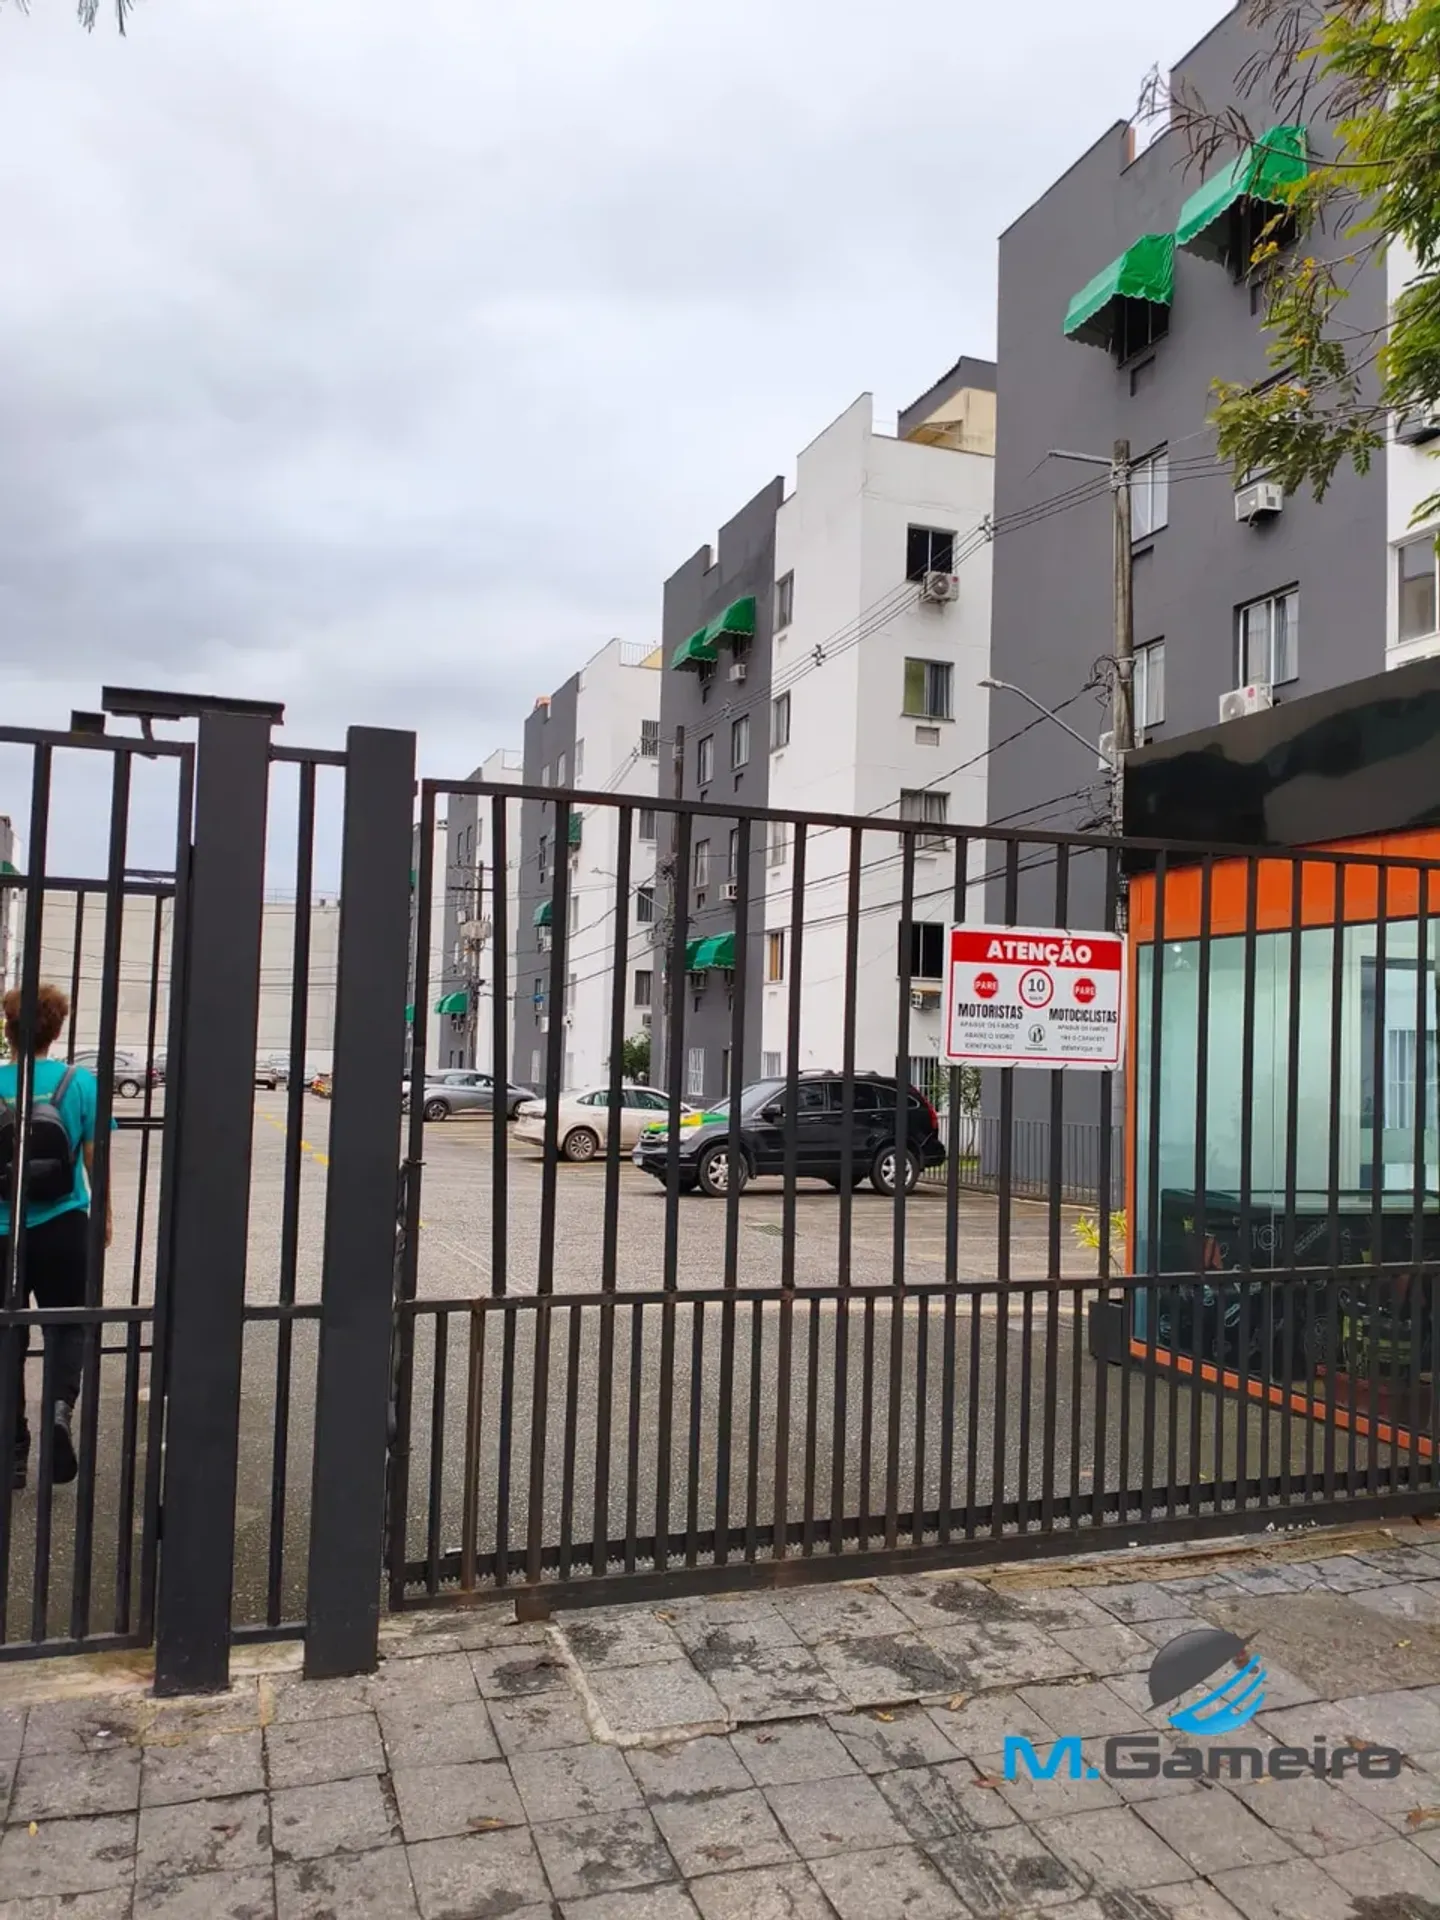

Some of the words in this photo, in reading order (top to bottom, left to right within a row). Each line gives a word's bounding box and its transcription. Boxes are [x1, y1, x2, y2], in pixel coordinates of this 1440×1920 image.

[987, 939, 1093, 968] ATENÇÃO
[974, 981, 998, 991] PARE
[1028, 978, 1046, 993] 10
[1074, 985, 1096, 996] PARE
[957, 1003, 1024, 1020] MOTORISTAS
[1048, 1008, 1117, 1023] MOTOCICLISTAS
